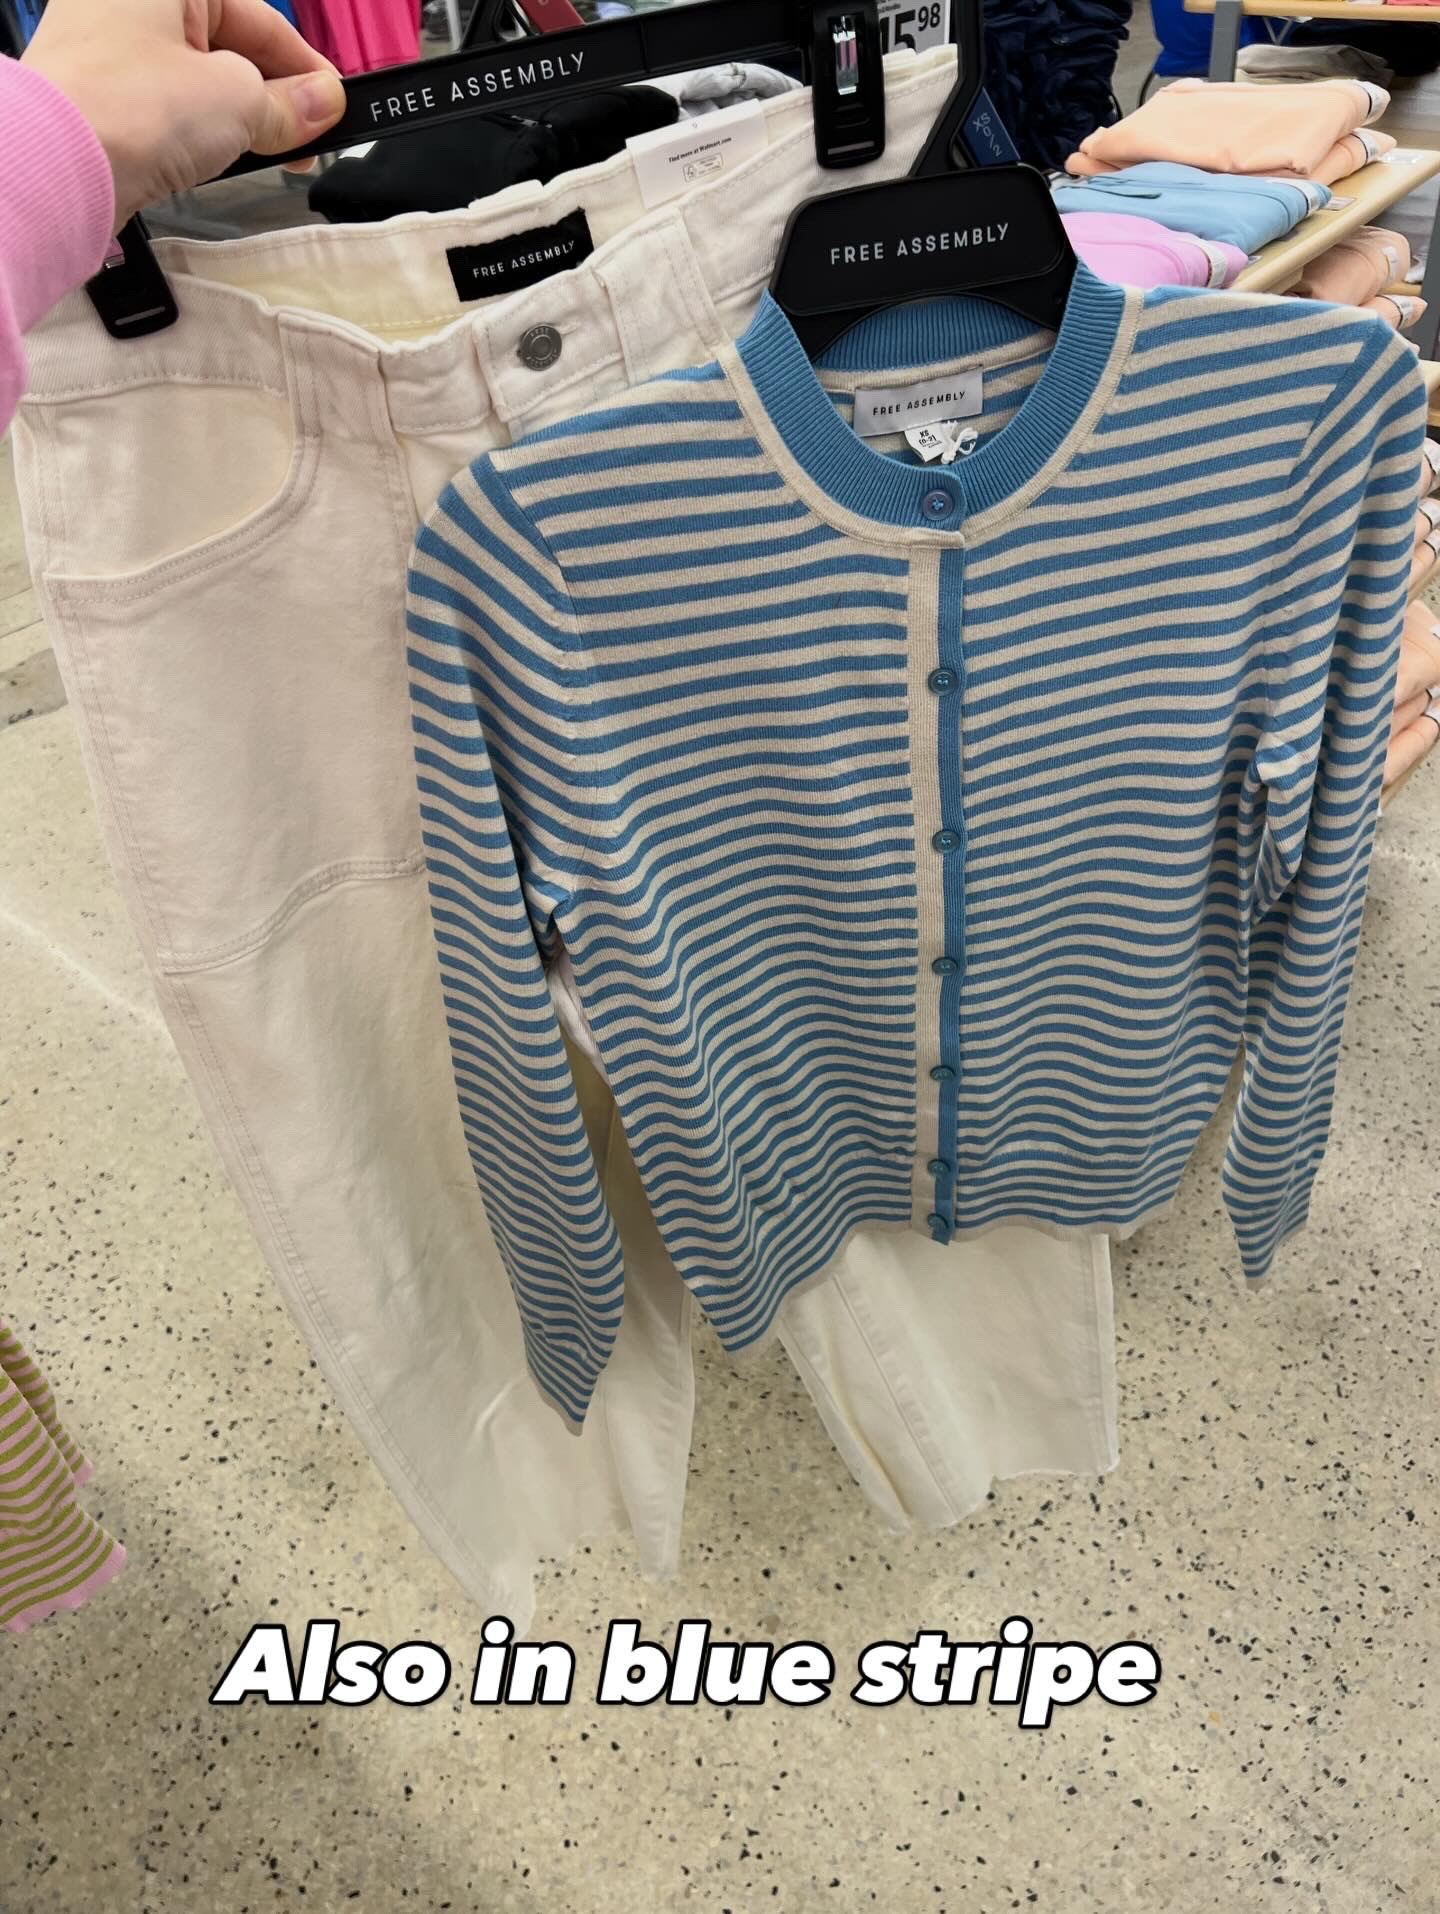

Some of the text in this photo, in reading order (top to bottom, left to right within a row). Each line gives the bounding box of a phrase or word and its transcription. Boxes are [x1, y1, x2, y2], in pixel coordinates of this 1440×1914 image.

[370, 51, 584, 122] FREE ASSEMBLY
[972, 112, 991, 133] XS
[668, 155, 680, 163] Find
[680, 151, 693, 160] more
[831, 222, 1009, 265] FREE ASSEMBLY
[472, 240, 575, 278] FREE ASSEMBLY
[872, 391, 966, 416] FREE ASSEMBLY
[919, 430, 930, 438] XS
